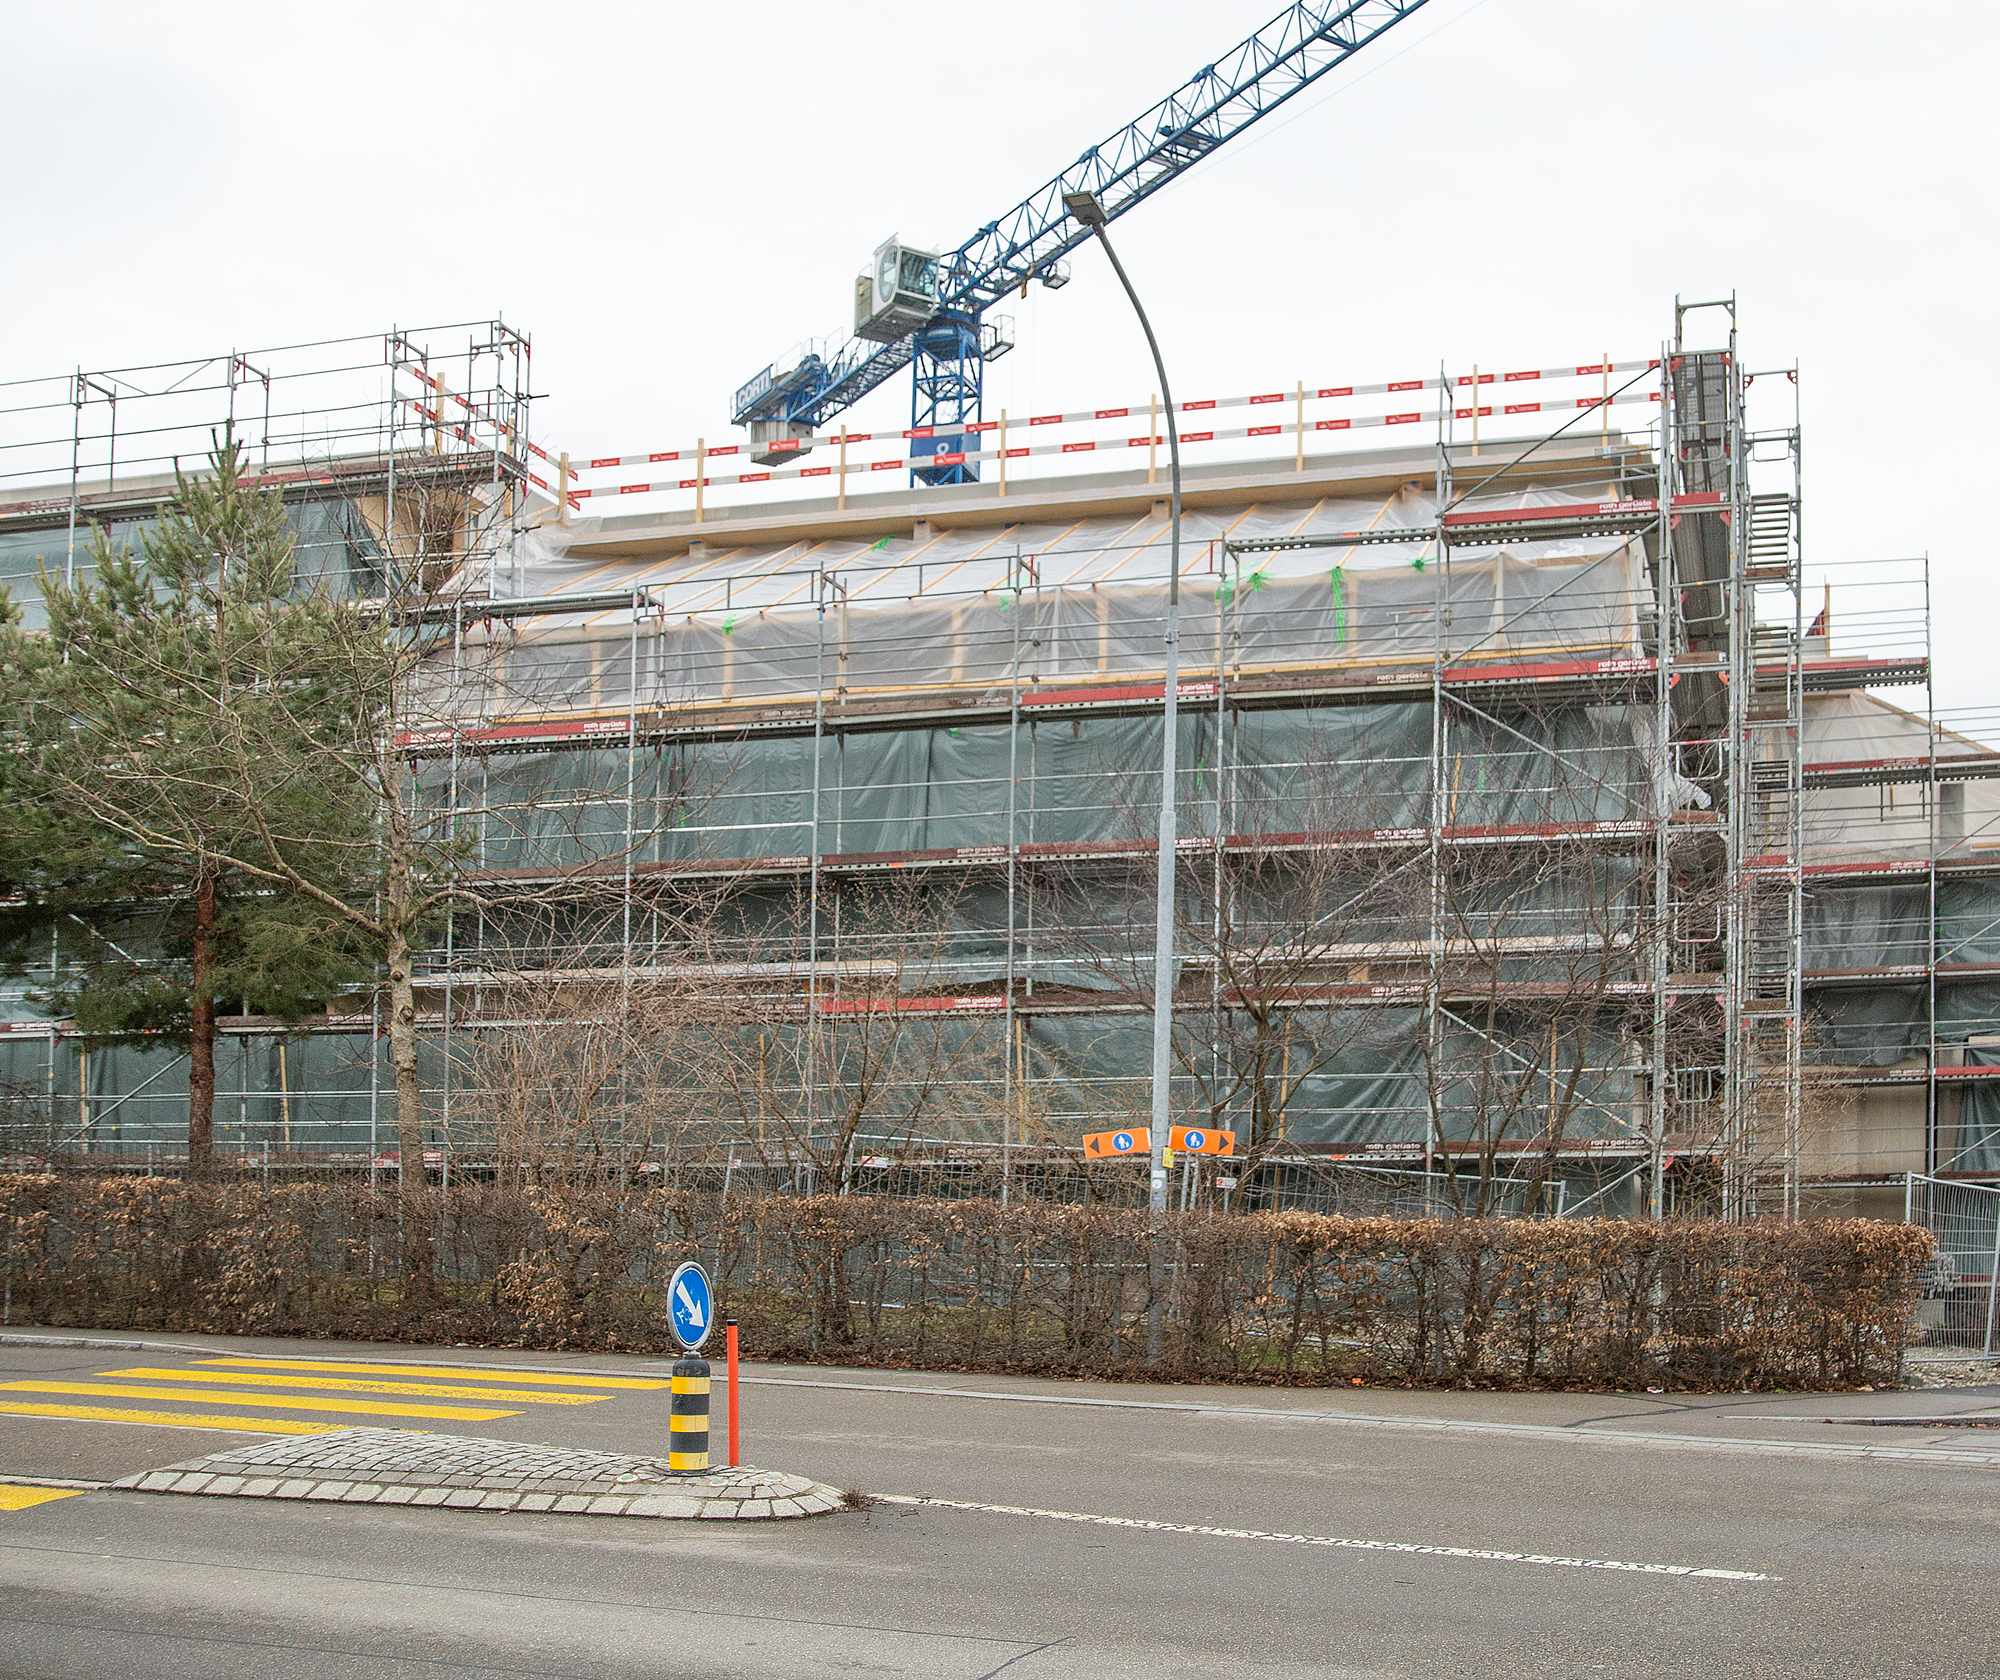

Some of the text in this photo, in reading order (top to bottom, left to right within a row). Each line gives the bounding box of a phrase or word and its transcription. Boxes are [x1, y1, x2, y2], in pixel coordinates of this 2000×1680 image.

[738, 370, 770, 408] CORTI
[1619, 500, 1652, 508] gerüste
[1598, 660, 1616, 668] roth
[1396, 672, 1427, 681] gerüste
